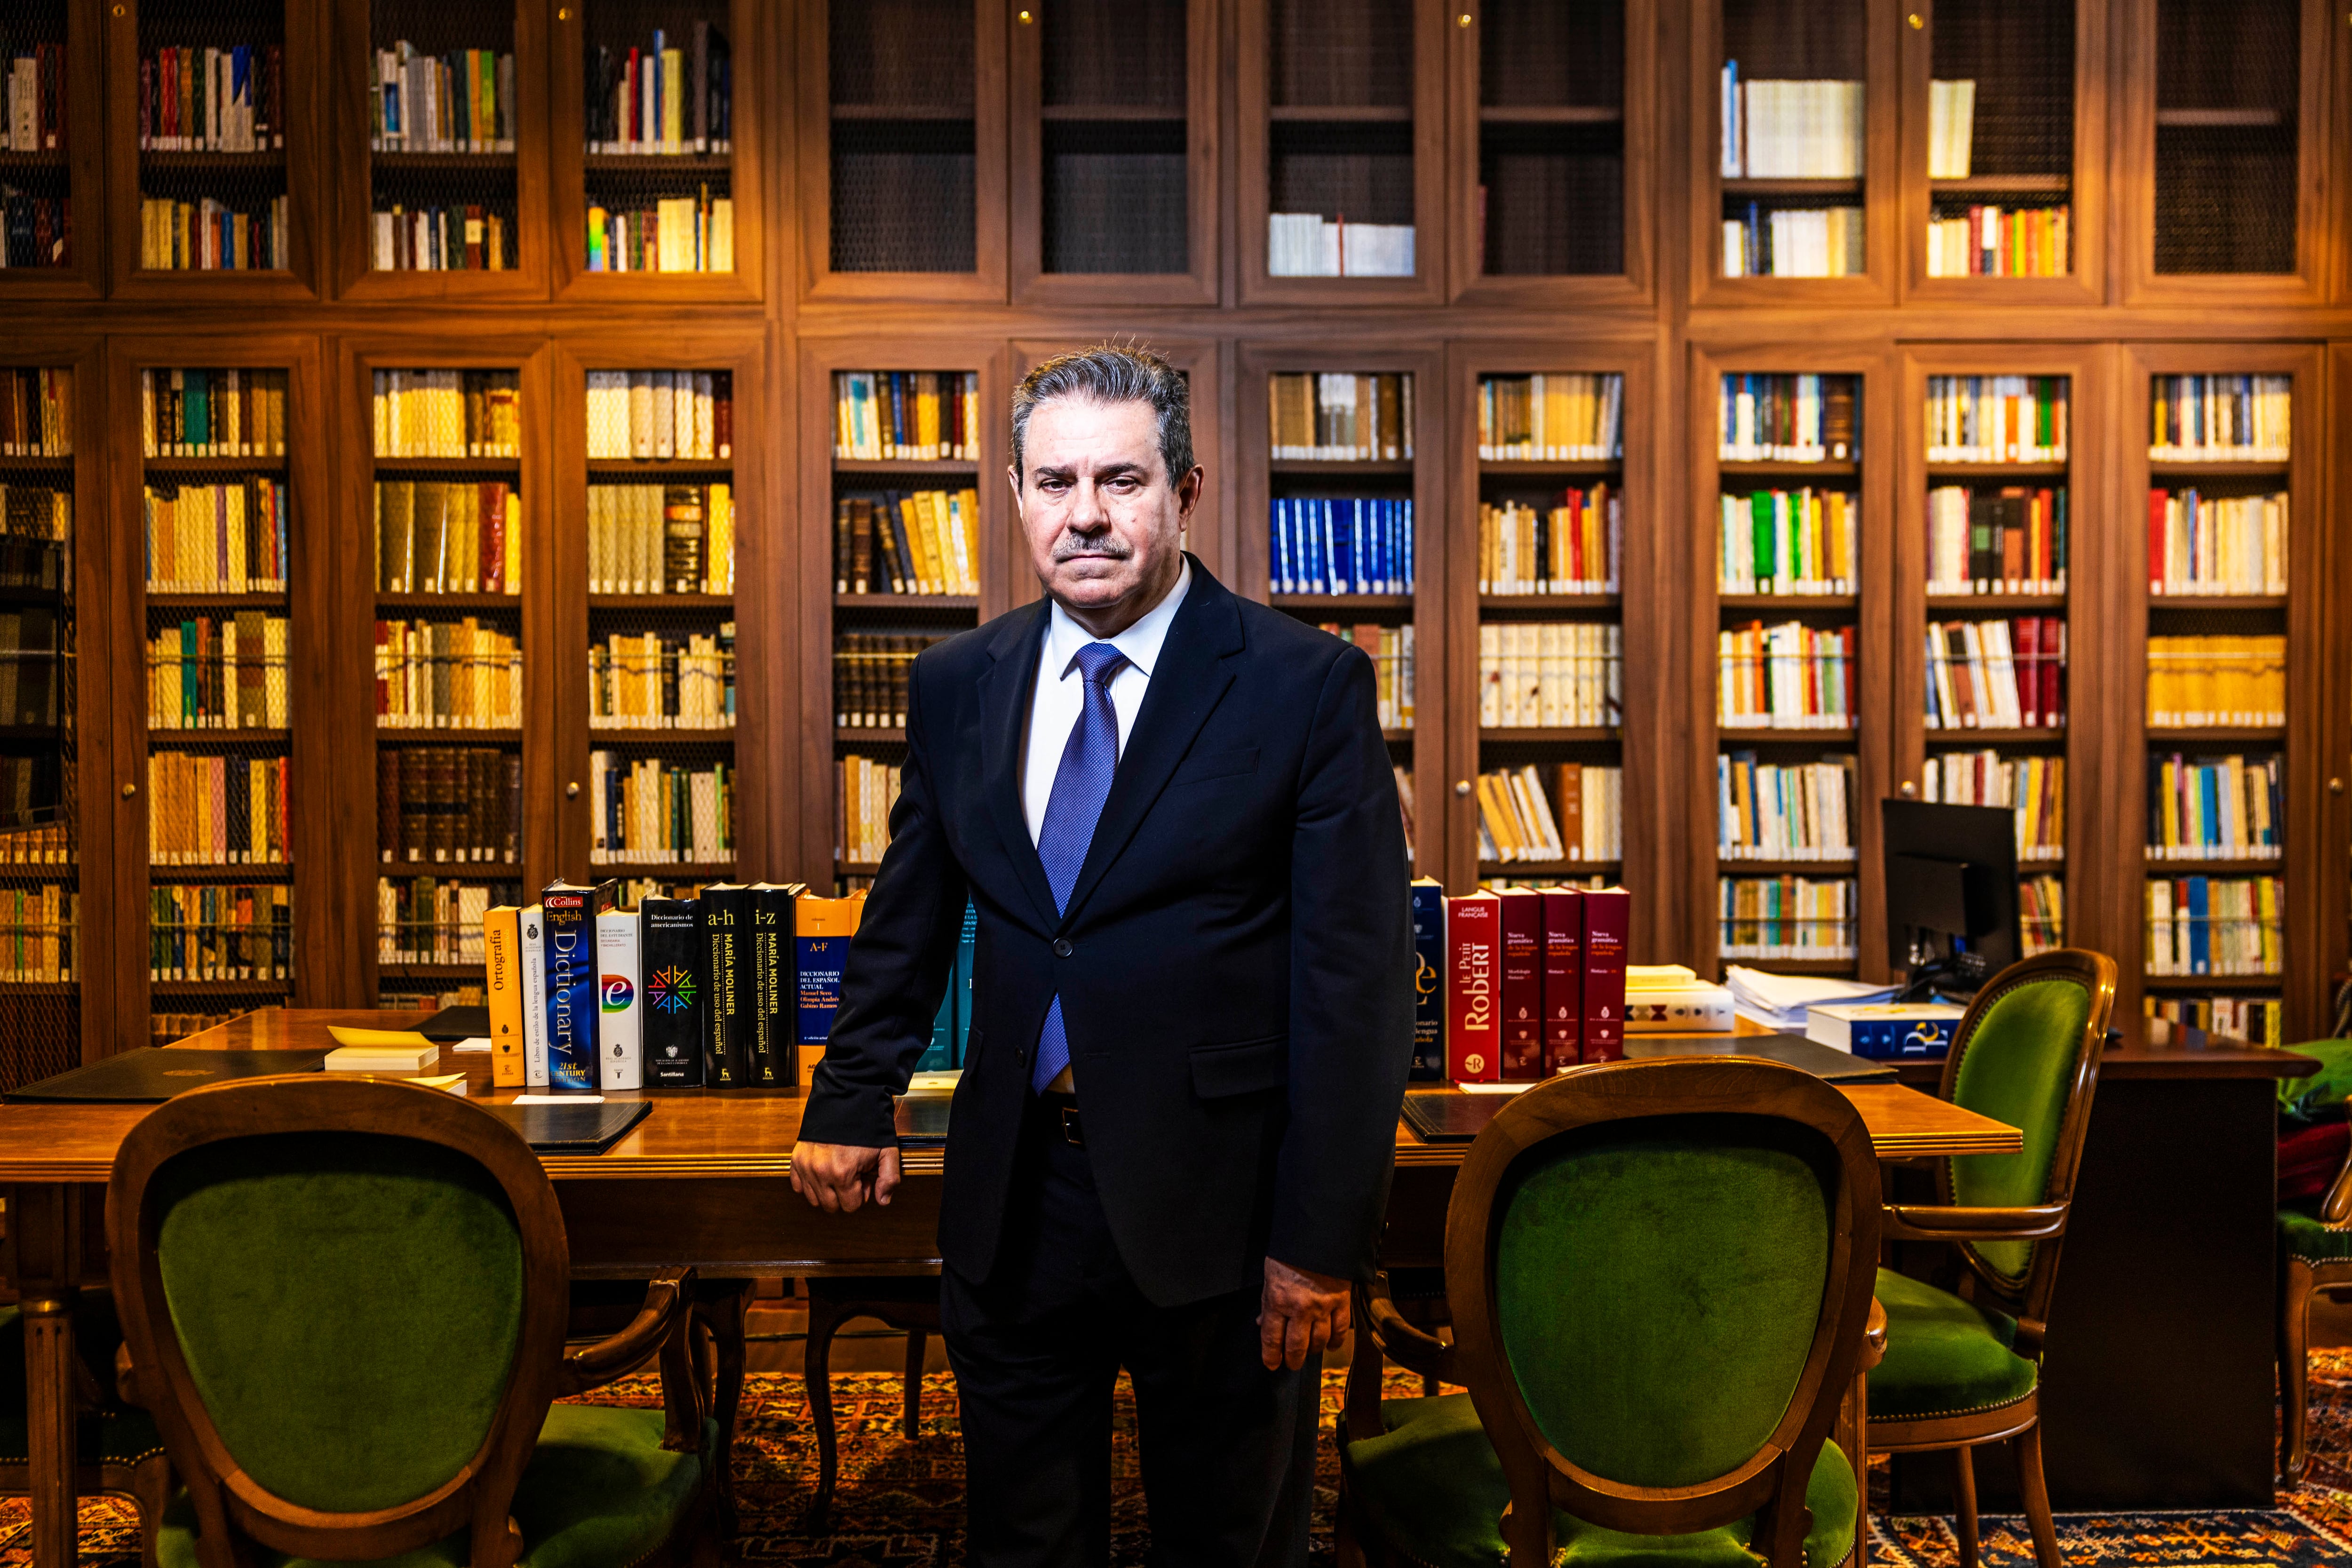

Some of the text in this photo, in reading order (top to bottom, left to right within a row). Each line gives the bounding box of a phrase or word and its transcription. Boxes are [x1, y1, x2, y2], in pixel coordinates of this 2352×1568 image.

[554, 898, 581, 906] Collins
[546, 909, 582, 926] English
[708, 908, 735, 925] a-h
[755, 908, 775, 924] i-z
[810, 942, 828, 952] A-F
[712, 933, 721, 980] Diccionario
[724, 934, 736, 1015] MARÍA MOLINER
[768, 933, 779, 1014] MARÍA MOLINER
[548, 930, 577, 1055] Dictionary
[714, 981, 721, 992] de
[757, 981, 764, 991] de
[714, 1023, 723, 1054] español
[756, 1022, 766, 1053] español
